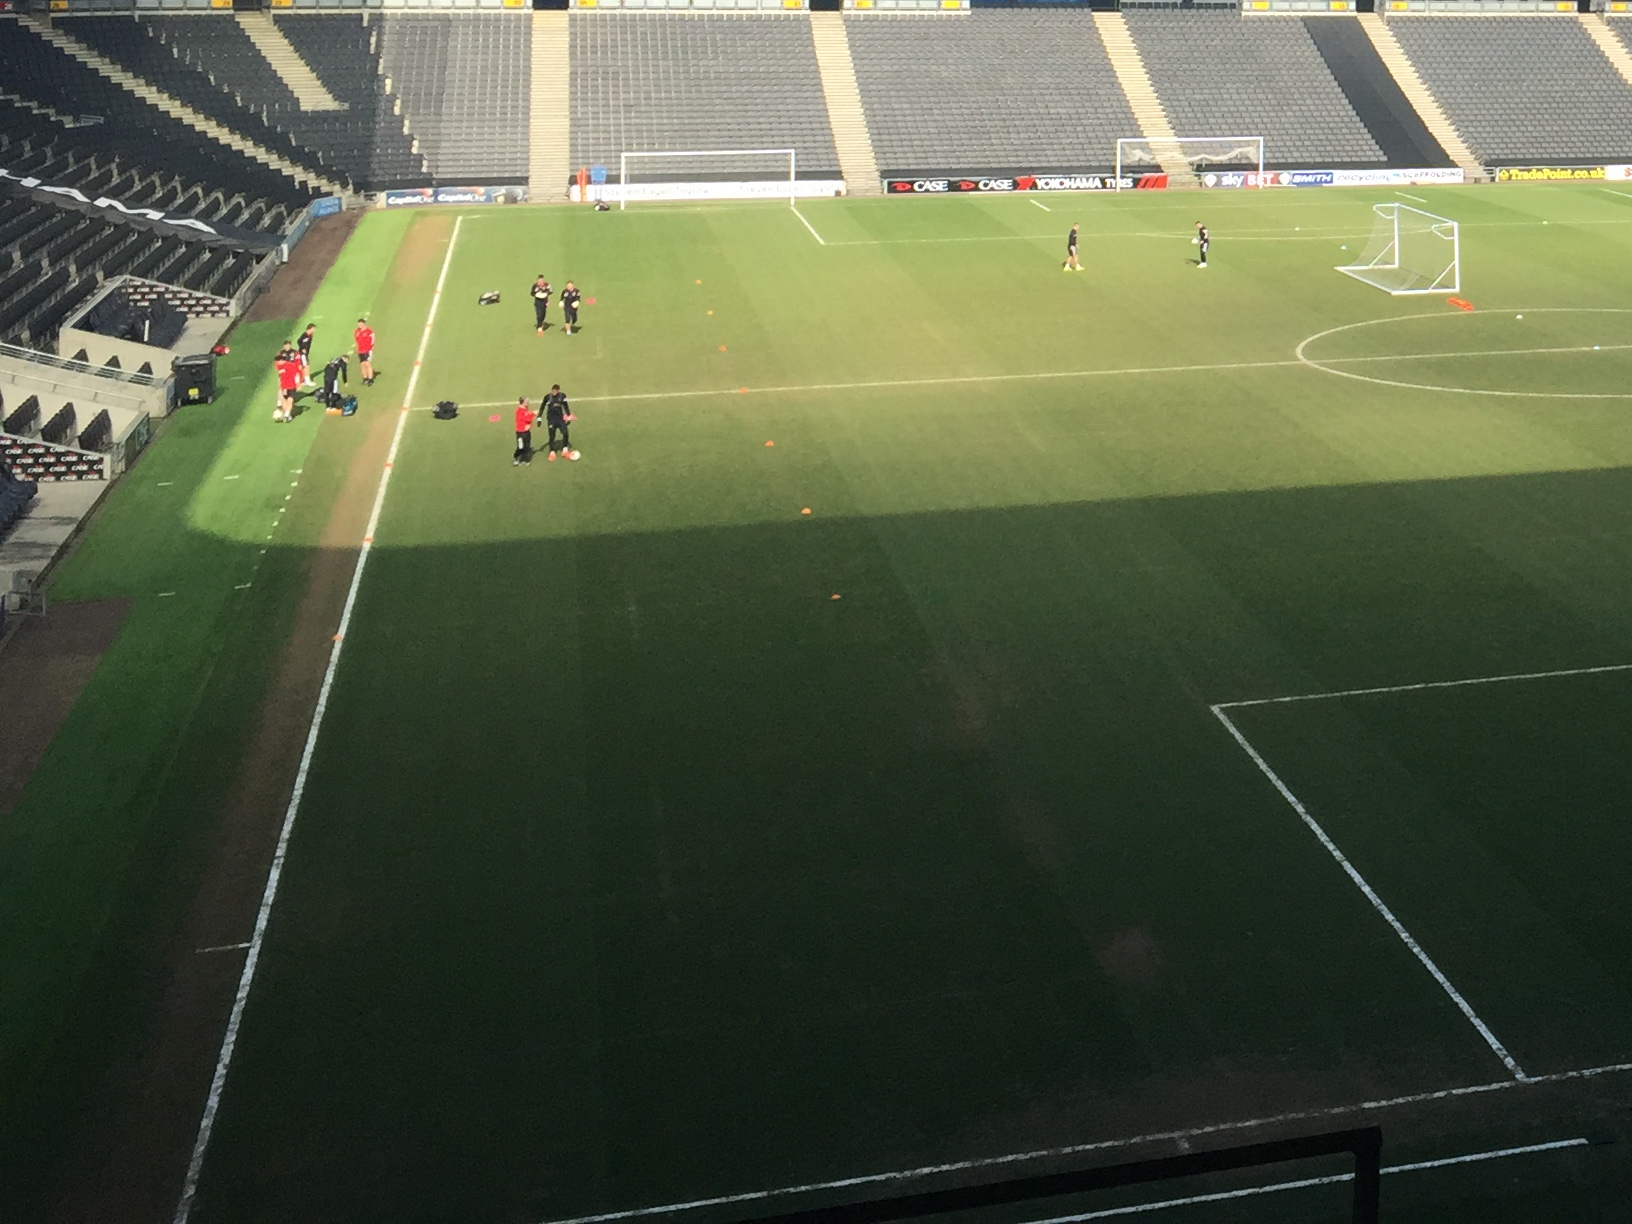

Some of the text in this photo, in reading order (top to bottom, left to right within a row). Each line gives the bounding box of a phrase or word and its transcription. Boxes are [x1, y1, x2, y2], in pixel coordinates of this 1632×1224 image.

[1292, 173, 1333, 183] SMITH
[1337, 172, 1391, 183] recycling
[1510, 167, 1605, 180] TradePoint.co.uk
[913, 180, 948, 192] CASE
[978, 179, 1013, 191] CASE
[1035, 177, 1101, 190] YOKOHAMA
[1221, 172, 1244, 188] sky
